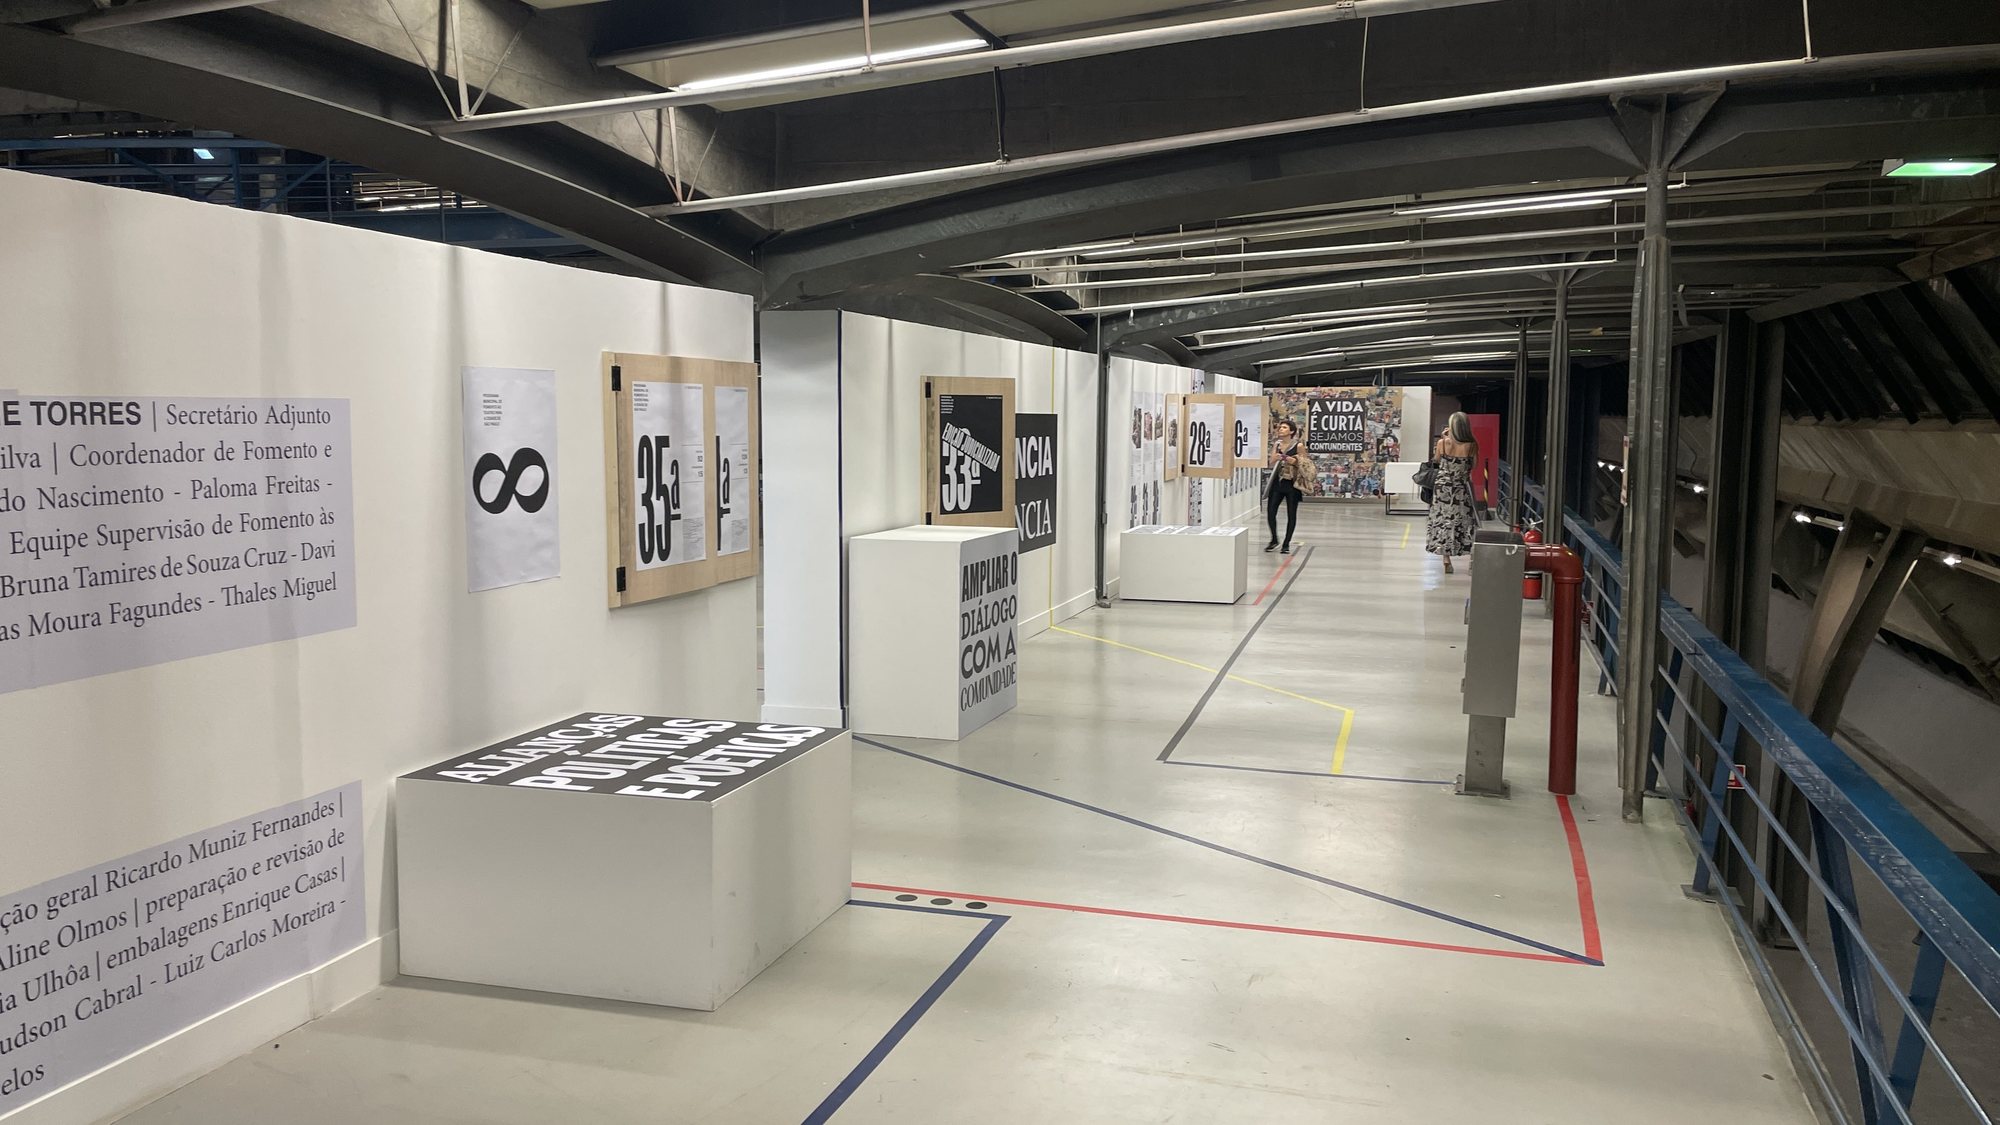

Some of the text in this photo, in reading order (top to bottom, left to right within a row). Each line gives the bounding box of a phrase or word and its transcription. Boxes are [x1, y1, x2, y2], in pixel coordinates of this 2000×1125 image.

[30, 401, 141, 426] TORRES
[166, 404, 258, 425] Secretário
[265, 404, 331, 430] Adjunto
[1310, 412, 1363, 430] É CURTA
[1311, 401, 1363, 412] A VIDA
[0, 445, 42, 469] ilva
[70, 442, 205, 466] Coordenador
[214, 440, 234, 460] de
[243, 441, 318, 460] Fomento
[324, 444, 332, 457] e
[1310, 432, 1363, 441] SEJAMOS
[1310, 442, 1362, 451] CONTUNDENTES
[37, 485, 164, 510] Nascimento
[191, 478, 258, 500] Paloma
[266, 475, 320, 494] Freitas
[9, 506, 334, 560] Equipe Supervisão de Fomento às
[0, 575, 70, 598] Bruna
[74, 562, 156, 588] Tamires
[161, 556, 182, 578] de
[187, 554, 240, 575] Souza
[244, 548, 288, 568] Cruz
[301, 540, 336, 561] Davi
[962, 551, 1018, 602] AMPLIAR O
[28, 612, 102, 636] Moura
[110, 592, 202, 628] Fagundes
[221, 582, 276, 606] Thales
[282, 572, 336, 600] Miguel
[962, 594, 1016, 640] DIÁLOGO
[961, 627, 1016, 680] COM A
[960, 662, 1016, 712] COMUNIDADE
[436, 714, 646, 784] ALIANÇAS
[508, 718, 738, 792] POLÍTICAS
[614, 724, 826, 800] E POÉTICAS
[0, 903, 38, 935] ção
[46, 874, 98, 920] geral
[106, 851, 182, 892] Ricardo
[188, 830, 247, 864] Muniz
[252, 802, 335, 842] Fernandes
[58, 911, 128, 948] Olmos
[146, 867, 247, 927] preparação
[252, 862, 261, 876] e
[266, 840, 324, 872] revisão
[328, 828, 344, 849] de
[23, 964, 90, 1002] Ulhôa
[106, 914, 218, 969] embalagens
[223, 885, 290, 923] Enrique
[295, 866, 338, 894] Casas
[75, 974, 143, 1020] Cabral
[164, 954, 205, 984] Luiz
[210, 930, 267, 962] Carlos
[272, 900, 336, 938] Moreira
